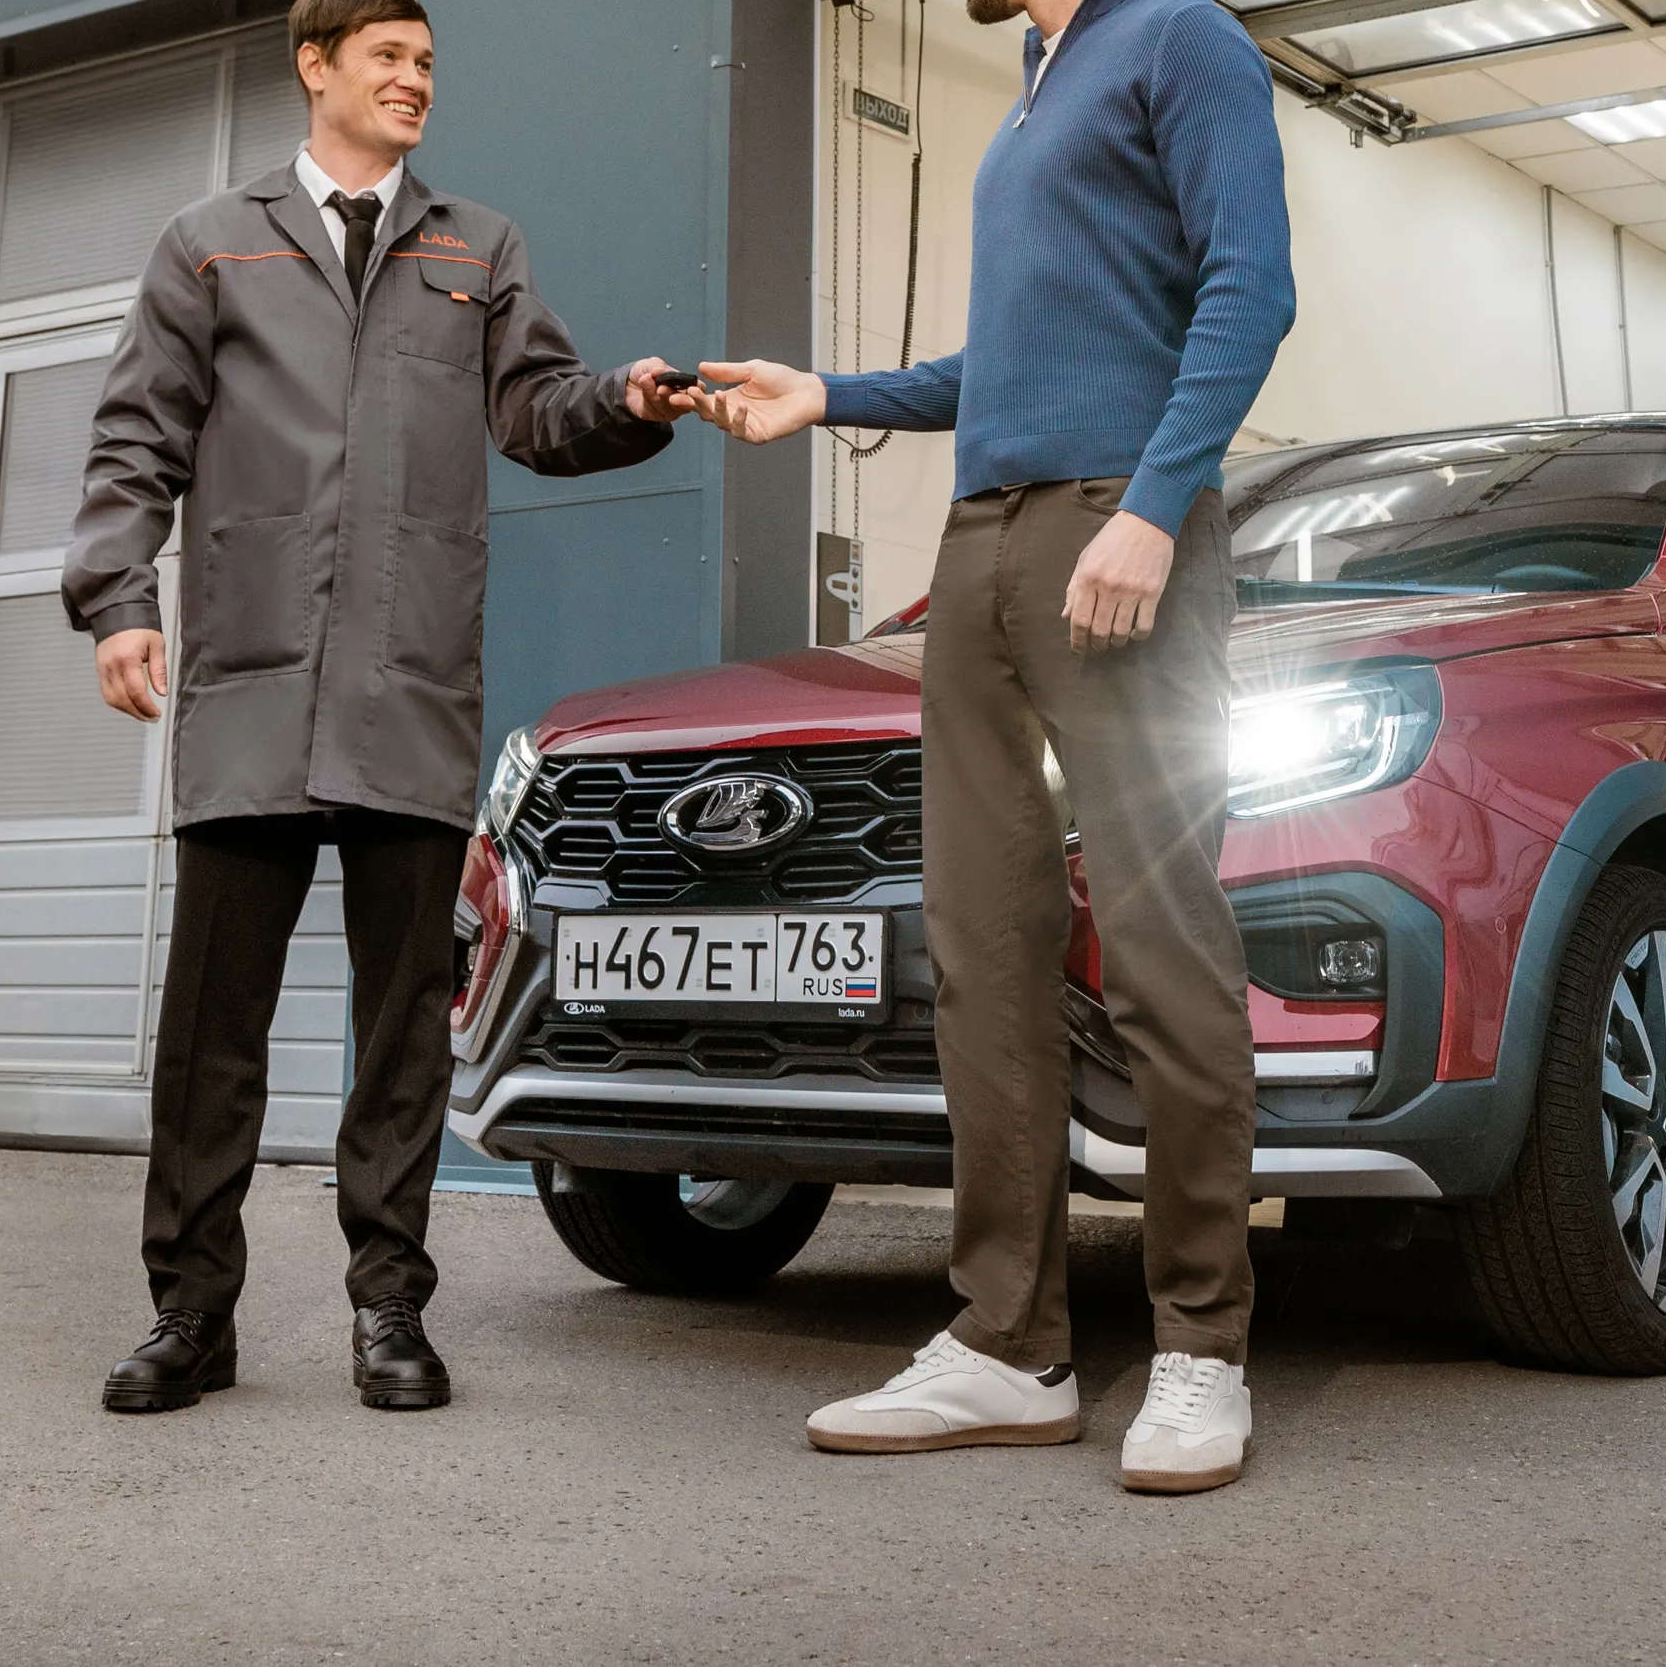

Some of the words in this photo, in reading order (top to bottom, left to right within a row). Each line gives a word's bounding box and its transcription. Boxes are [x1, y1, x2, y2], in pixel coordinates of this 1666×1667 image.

[855, 92, 908, 128] ВЫХОД
[419, 231, 469, 250] LADA
[783, 921, 866, 972] 763
[802, 978, 844, 997] RUS
[585, 1004, 606, 1014] LADA
[838, 1007, 865, 1018] lada.ru
